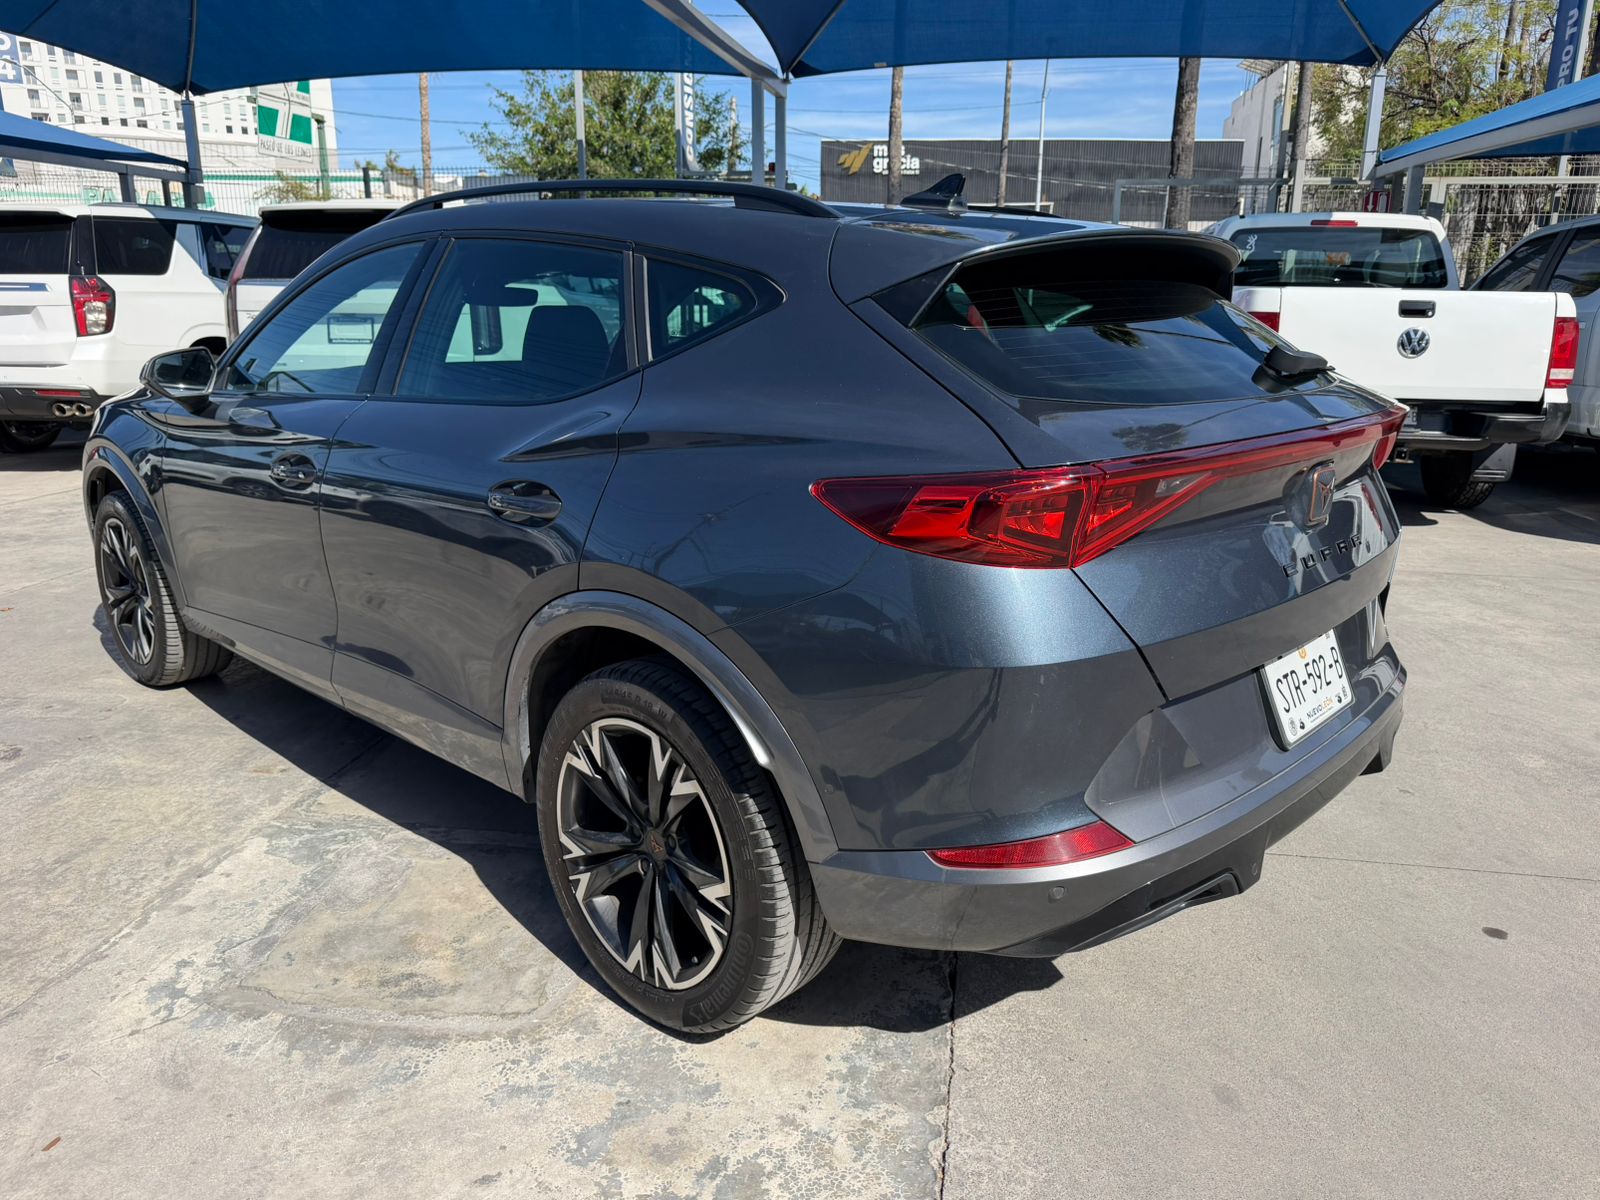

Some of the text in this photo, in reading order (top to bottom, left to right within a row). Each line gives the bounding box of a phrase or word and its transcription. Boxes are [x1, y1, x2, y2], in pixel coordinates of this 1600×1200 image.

[1565, 7, 1579, 40] TU
[873, 144, 905, 157] ms
[873, 154, 920, 173] grcia
[1275, 646, 1343, 713] STR-592-B
